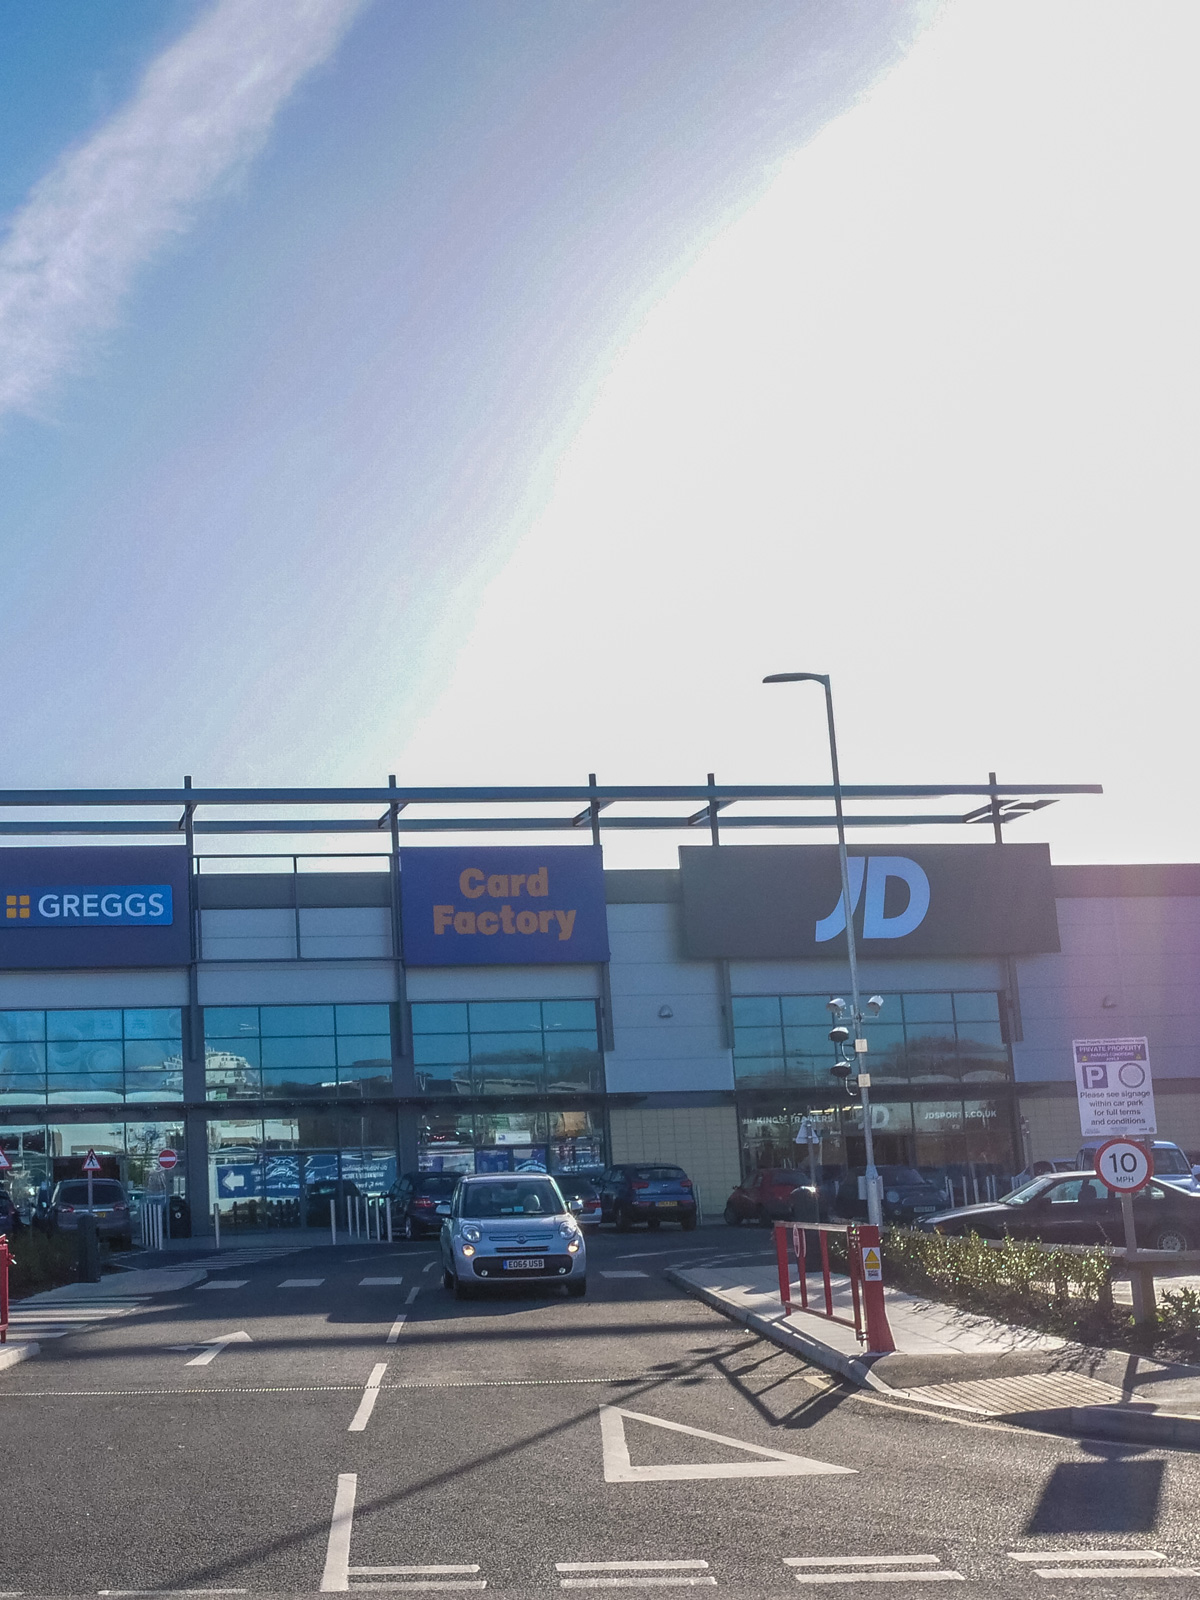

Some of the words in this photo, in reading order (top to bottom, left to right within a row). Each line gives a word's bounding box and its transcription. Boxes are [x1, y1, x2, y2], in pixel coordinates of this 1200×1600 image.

[458, 866, 549, 899] Card
[38, 893, 164, 918] GREGGS
[815, 856, 931, 943] JD
[433, 904, 577, 941] Factory
[1086, 1066, 1104, 1088] P
[1109, 1152, 1138, 1173] 10
